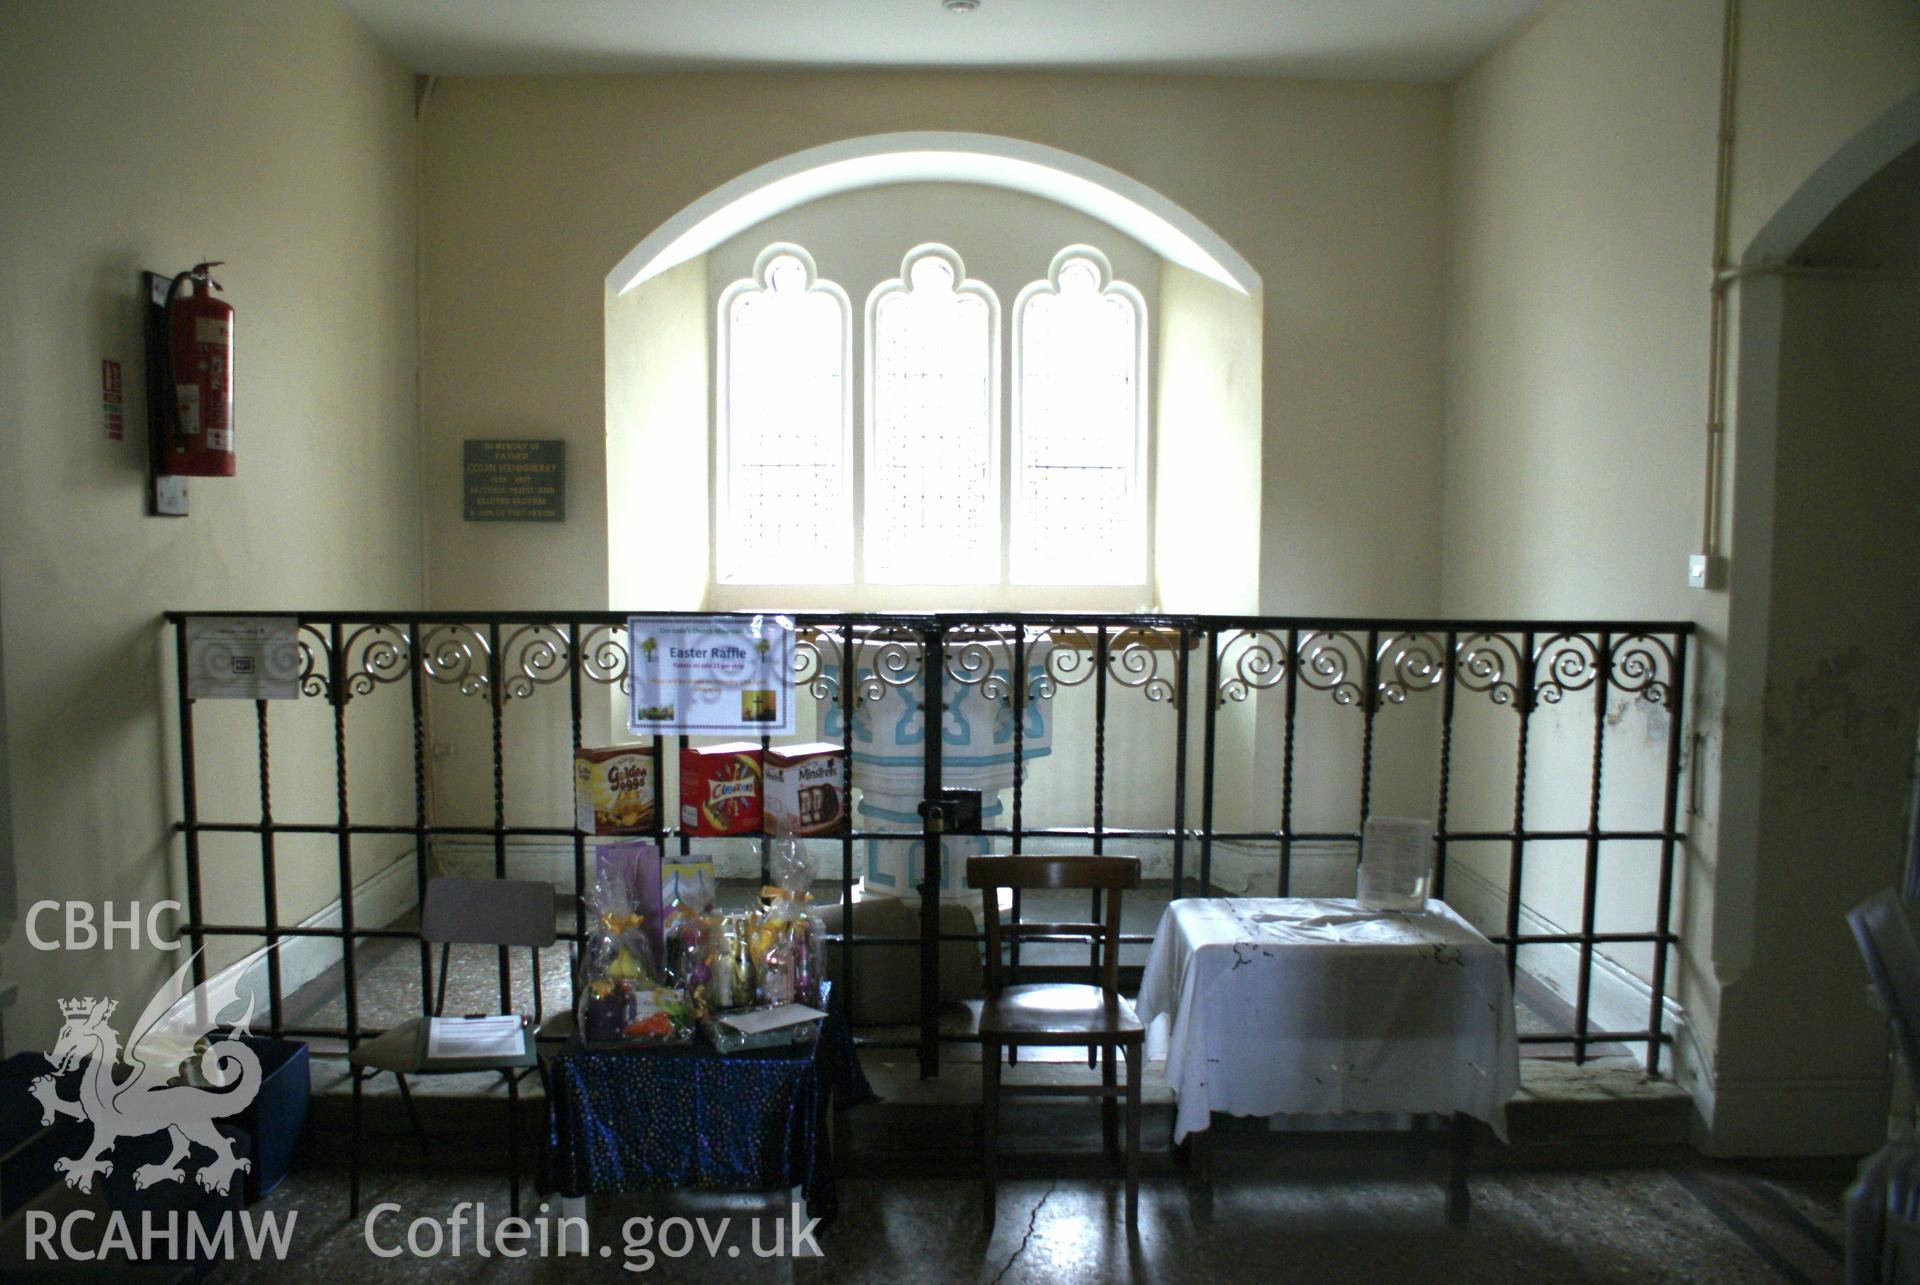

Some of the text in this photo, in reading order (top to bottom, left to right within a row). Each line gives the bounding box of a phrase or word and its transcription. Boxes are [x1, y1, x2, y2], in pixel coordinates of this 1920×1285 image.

[669, 647, 747, 659] Easter Raffle
[608, 764, 648, 791] Golden
[798, 766, 838, 781] Minstrels
